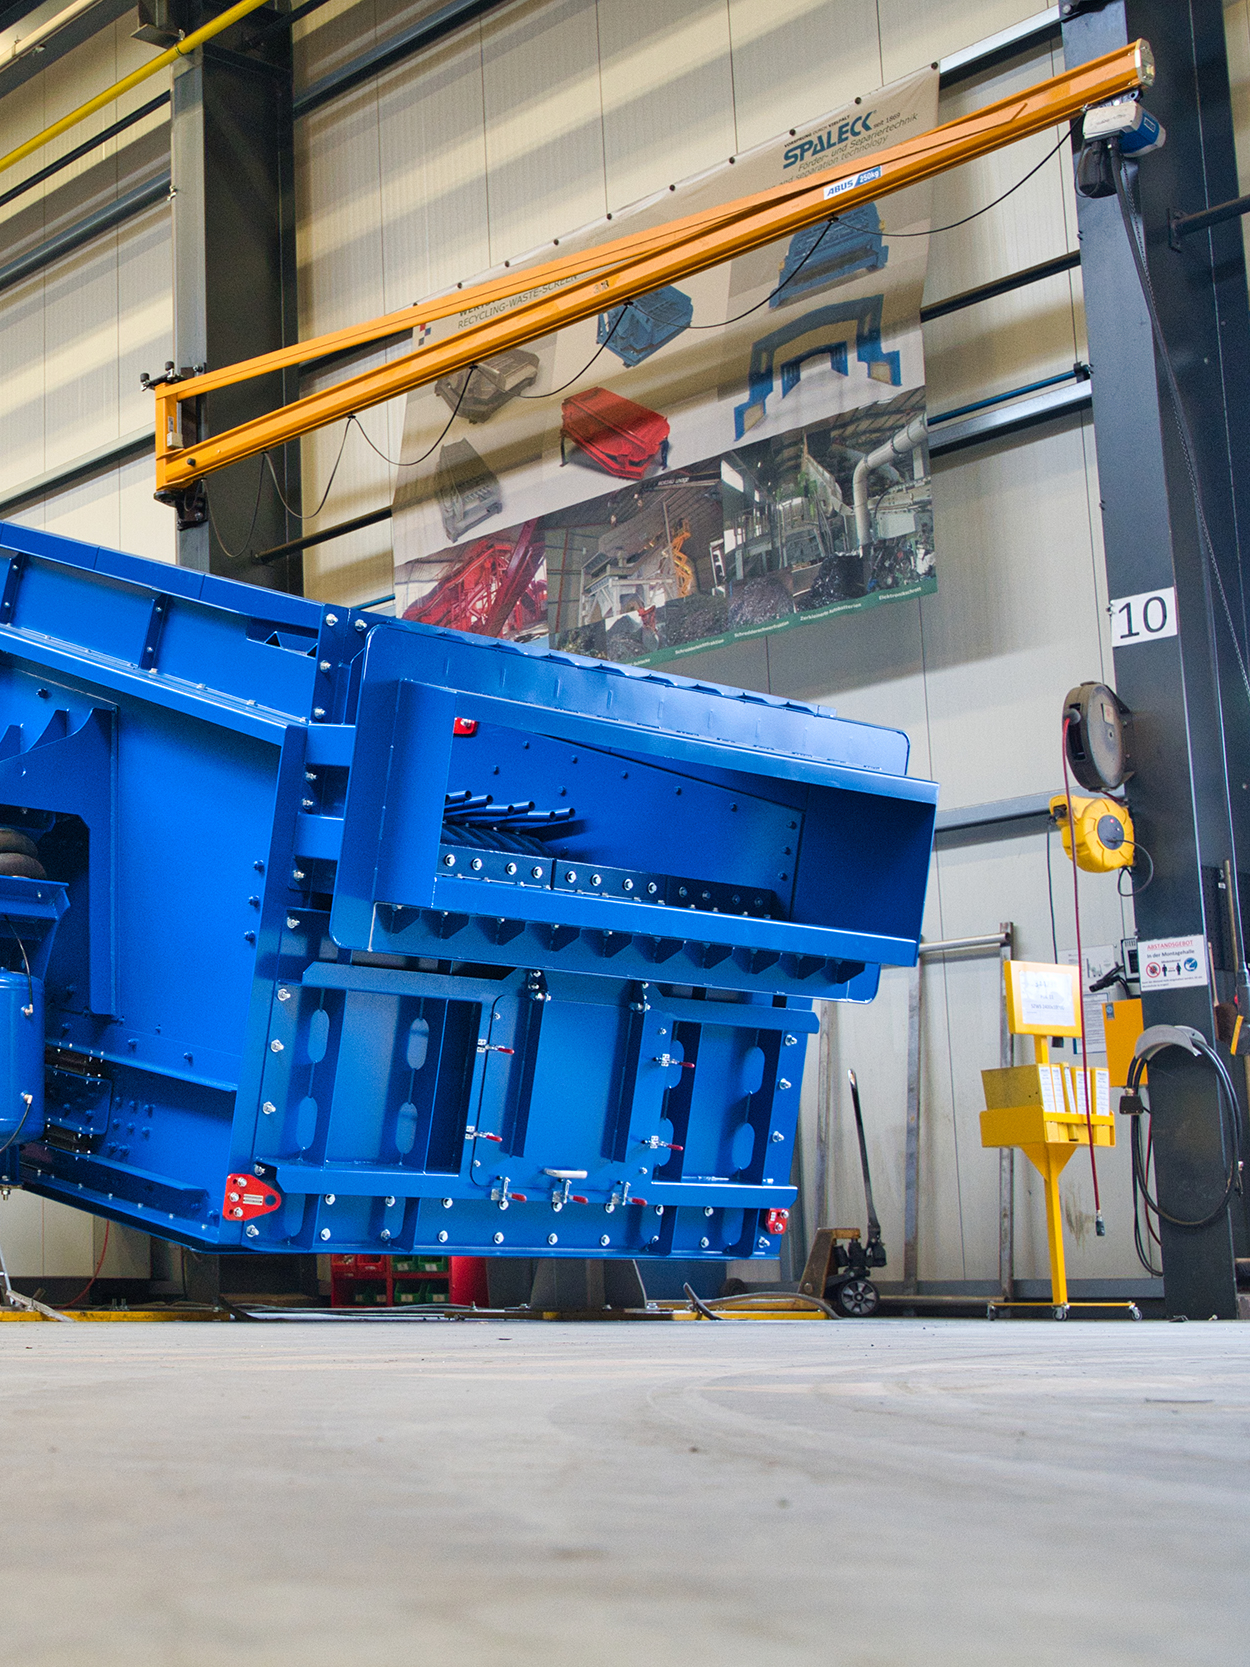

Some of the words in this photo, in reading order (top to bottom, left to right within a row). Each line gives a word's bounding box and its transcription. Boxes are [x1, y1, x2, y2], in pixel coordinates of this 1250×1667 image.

[783, 110, 874, 169] SPALECK
[831, 144, 849, 157] und
[849, 113, 919, 150] Separiertechnik
[841, 134, 889, 162] technology
[826, 180, 854, 197] ABUS
[859, 168, 880, 183] 250kg
[1118, 595, 1167, 639] 10
[1147, 940, 1193, 950] ABSTANDSGEBOT
